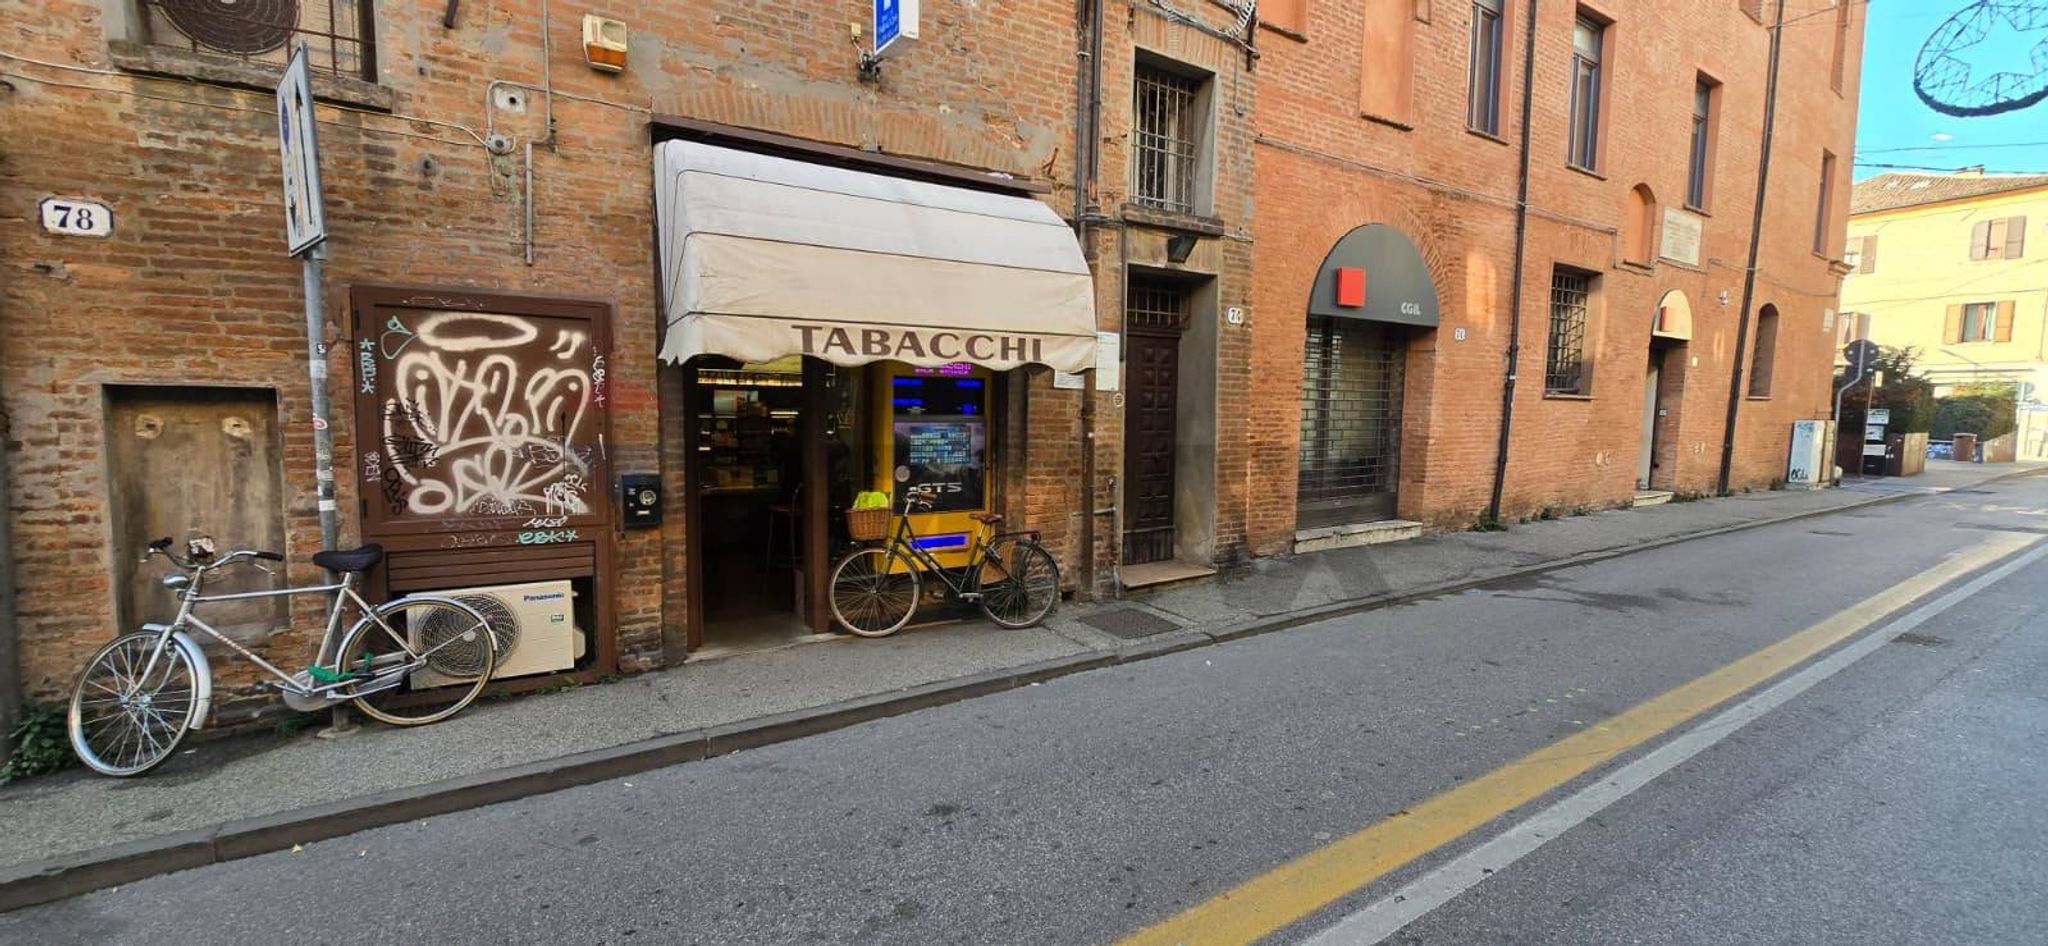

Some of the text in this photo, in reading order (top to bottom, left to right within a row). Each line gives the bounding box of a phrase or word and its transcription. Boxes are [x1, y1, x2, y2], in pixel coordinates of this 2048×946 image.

[53, 205, 94, 230] 78
[1401, 302, 1421, 315] CGIL
[791, 325, 1042, 362] TABACCHI
[917, 482, 962, 493] GTS
[523, 592, 564, 602] Panasonic
